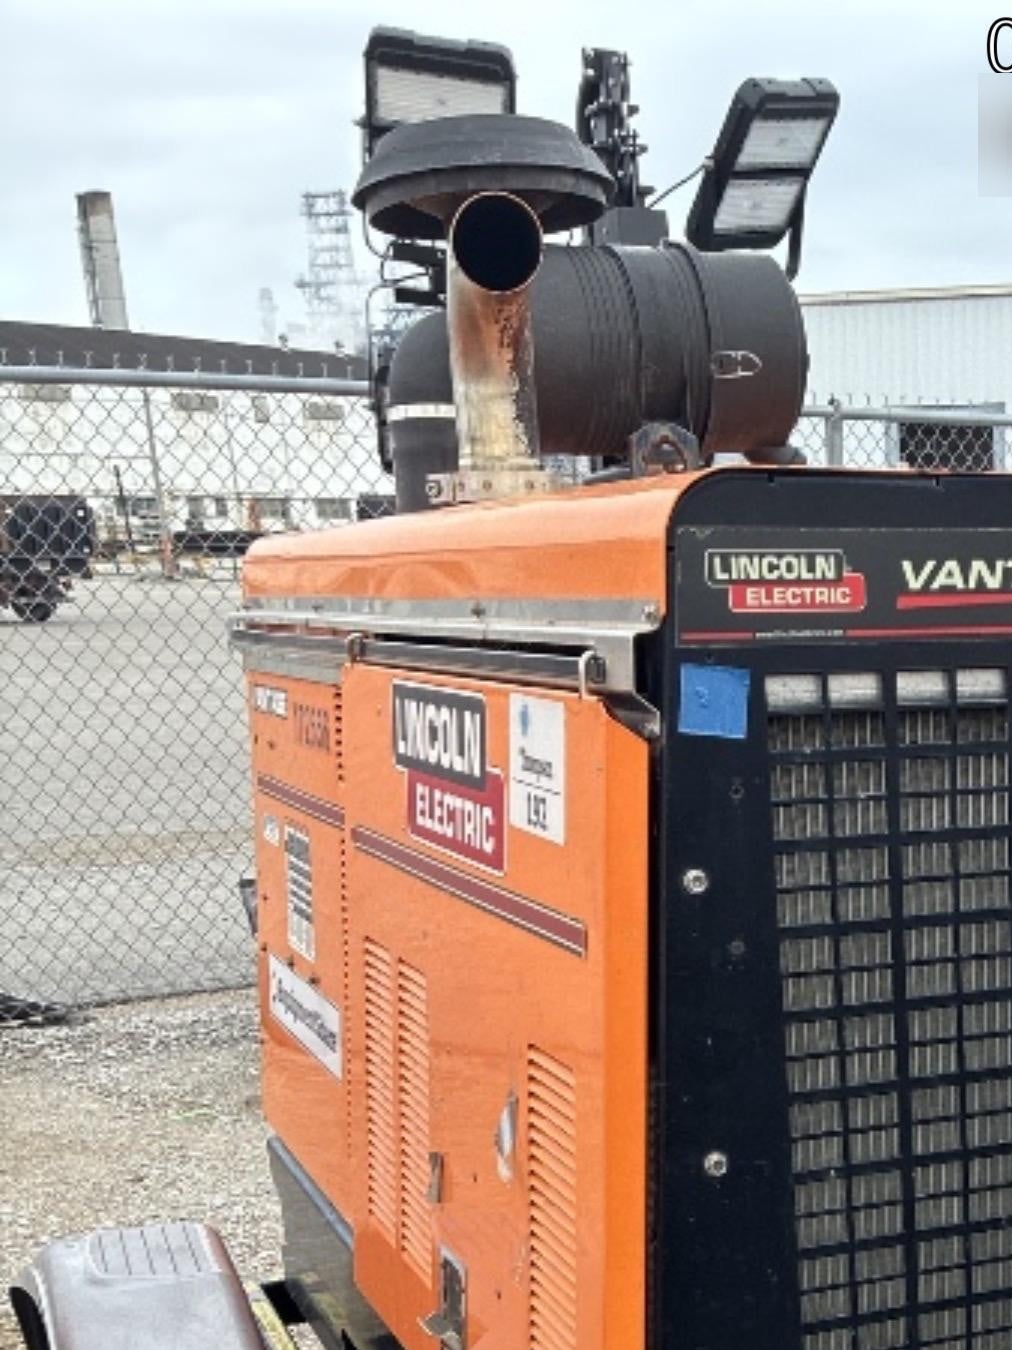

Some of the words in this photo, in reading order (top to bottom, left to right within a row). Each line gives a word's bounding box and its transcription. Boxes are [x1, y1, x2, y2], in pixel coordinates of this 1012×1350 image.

[713, 554, 836, 580] LINCOLN
[746, 587, 852, 606] ELECTRIC
[395, 696, 481, 778] LINCOLN
[416, 782, 495, 853] ELECTRIC
